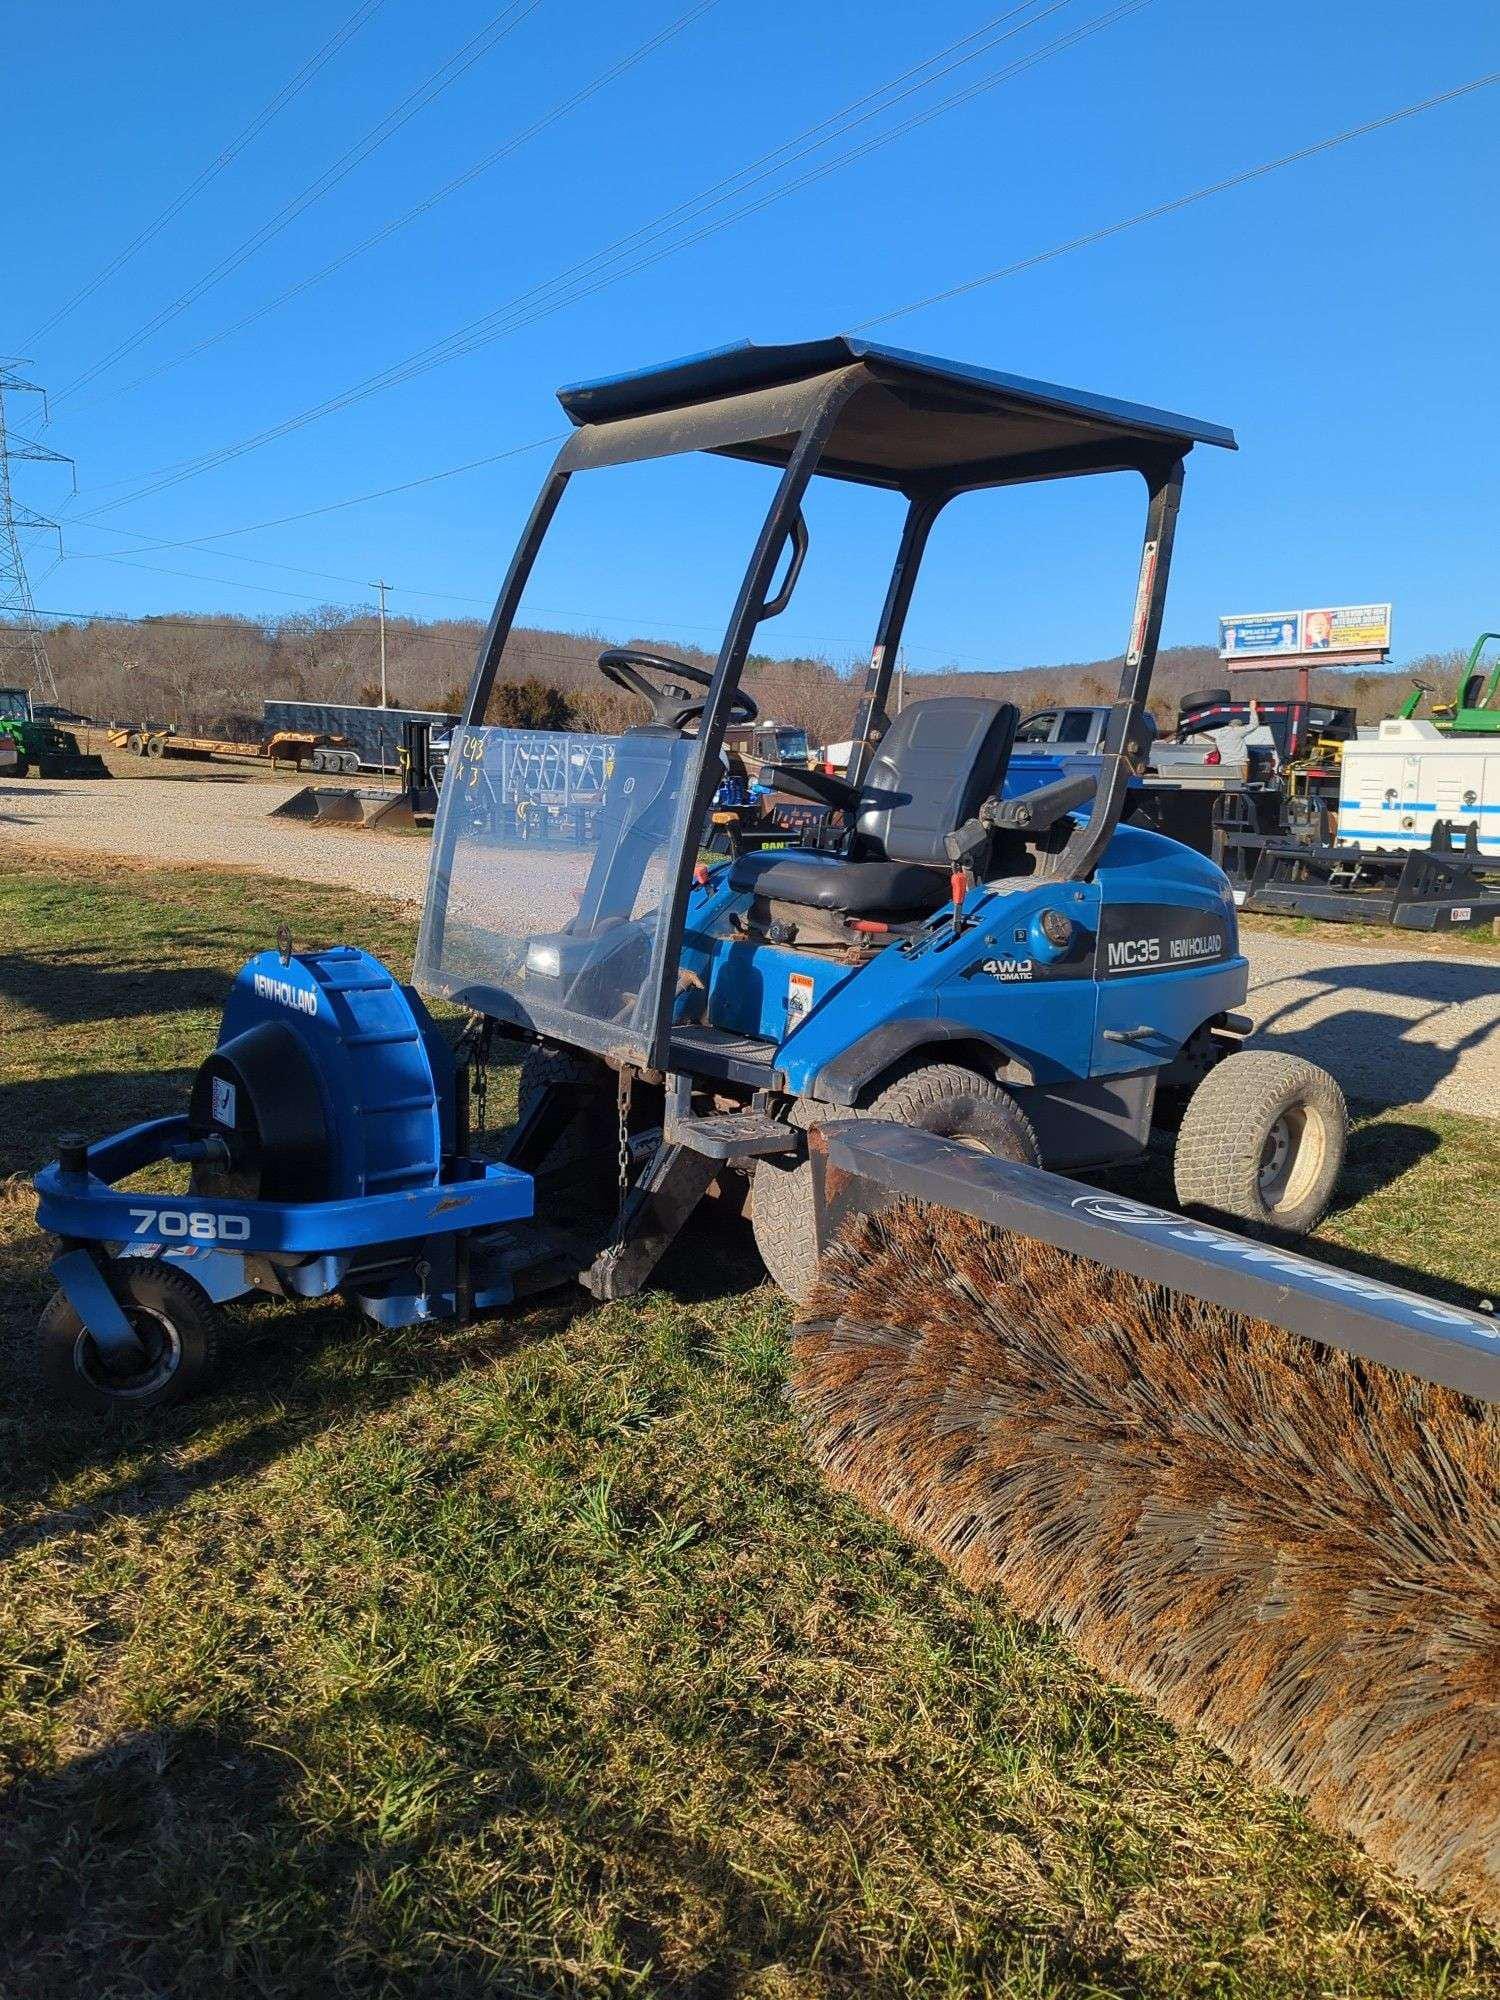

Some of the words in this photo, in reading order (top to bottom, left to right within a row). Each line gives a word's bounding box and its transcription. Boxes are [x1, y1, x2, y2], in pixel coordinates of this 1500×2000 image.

[1107, 938, 1160, 967] MC35
[990, 972, 1033, 982] TOMATIC
[129, 1208, 250, 1241] 708D
